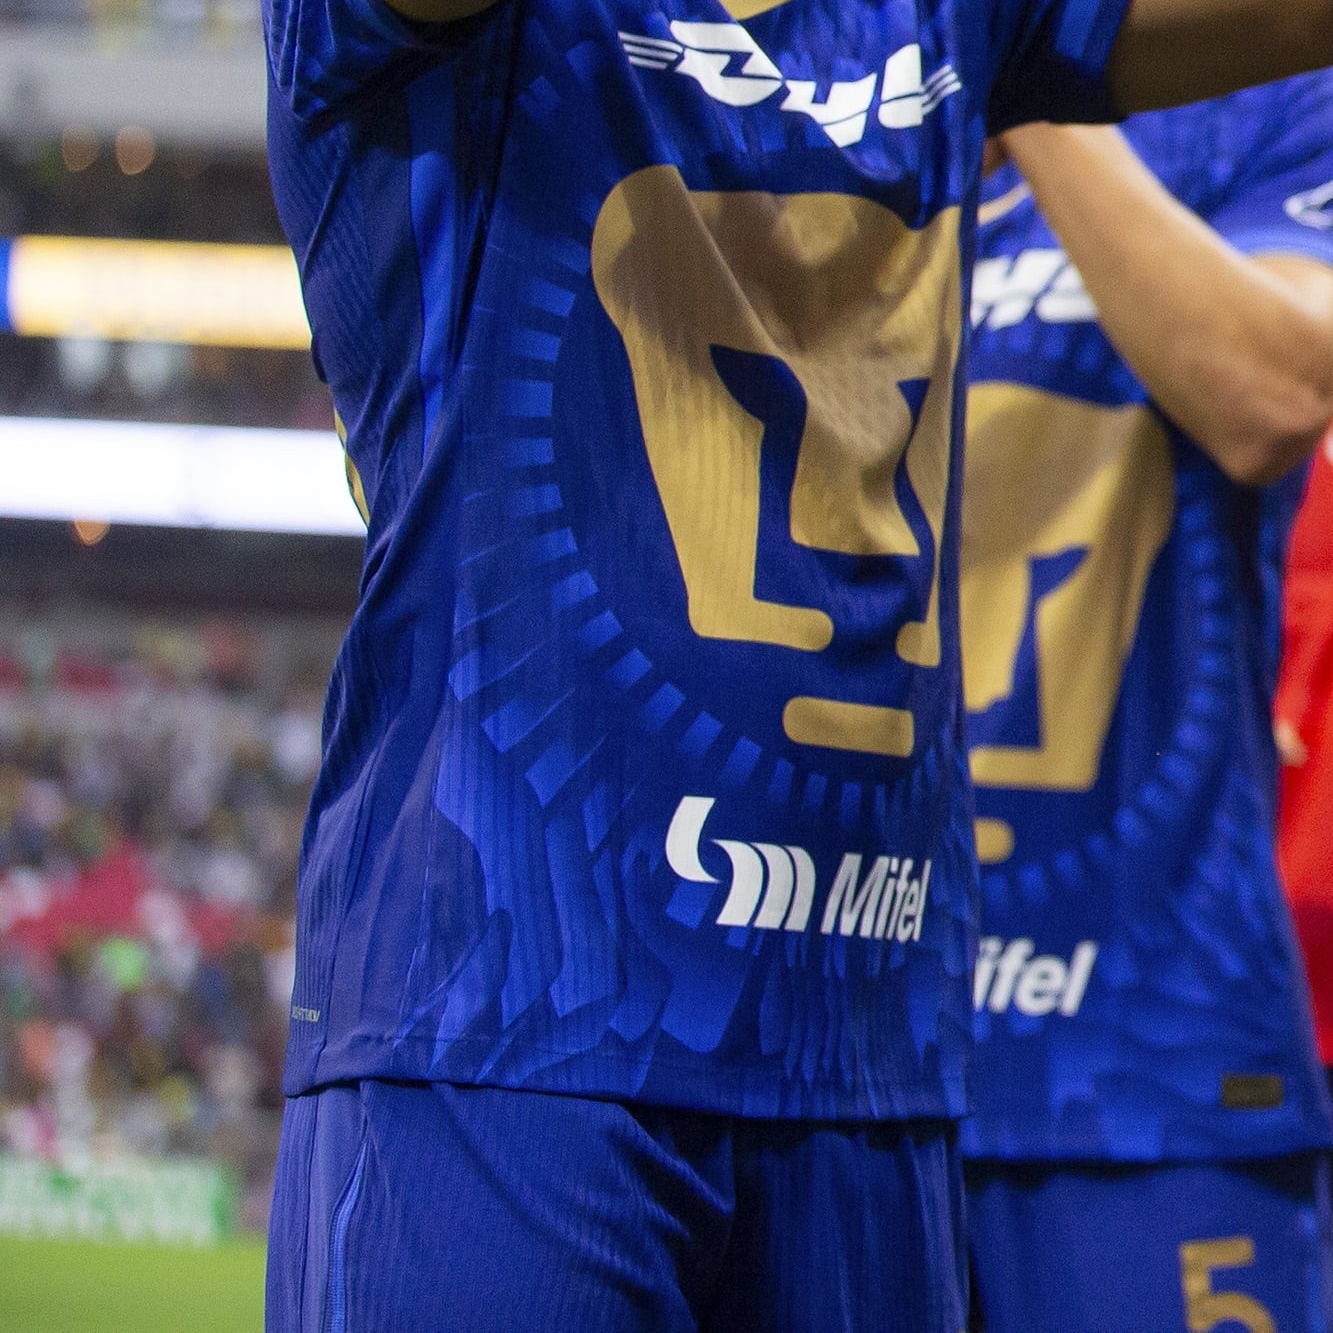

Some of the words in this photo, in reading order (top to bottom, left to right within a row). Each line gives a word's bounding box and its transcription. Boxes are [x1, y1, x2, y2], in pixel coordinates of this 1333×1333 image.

[820, 852, 932, 943] Mifel
[973, 935, 1099, 1018] ifel
[1180, 1236, 1277, 1333] 5
